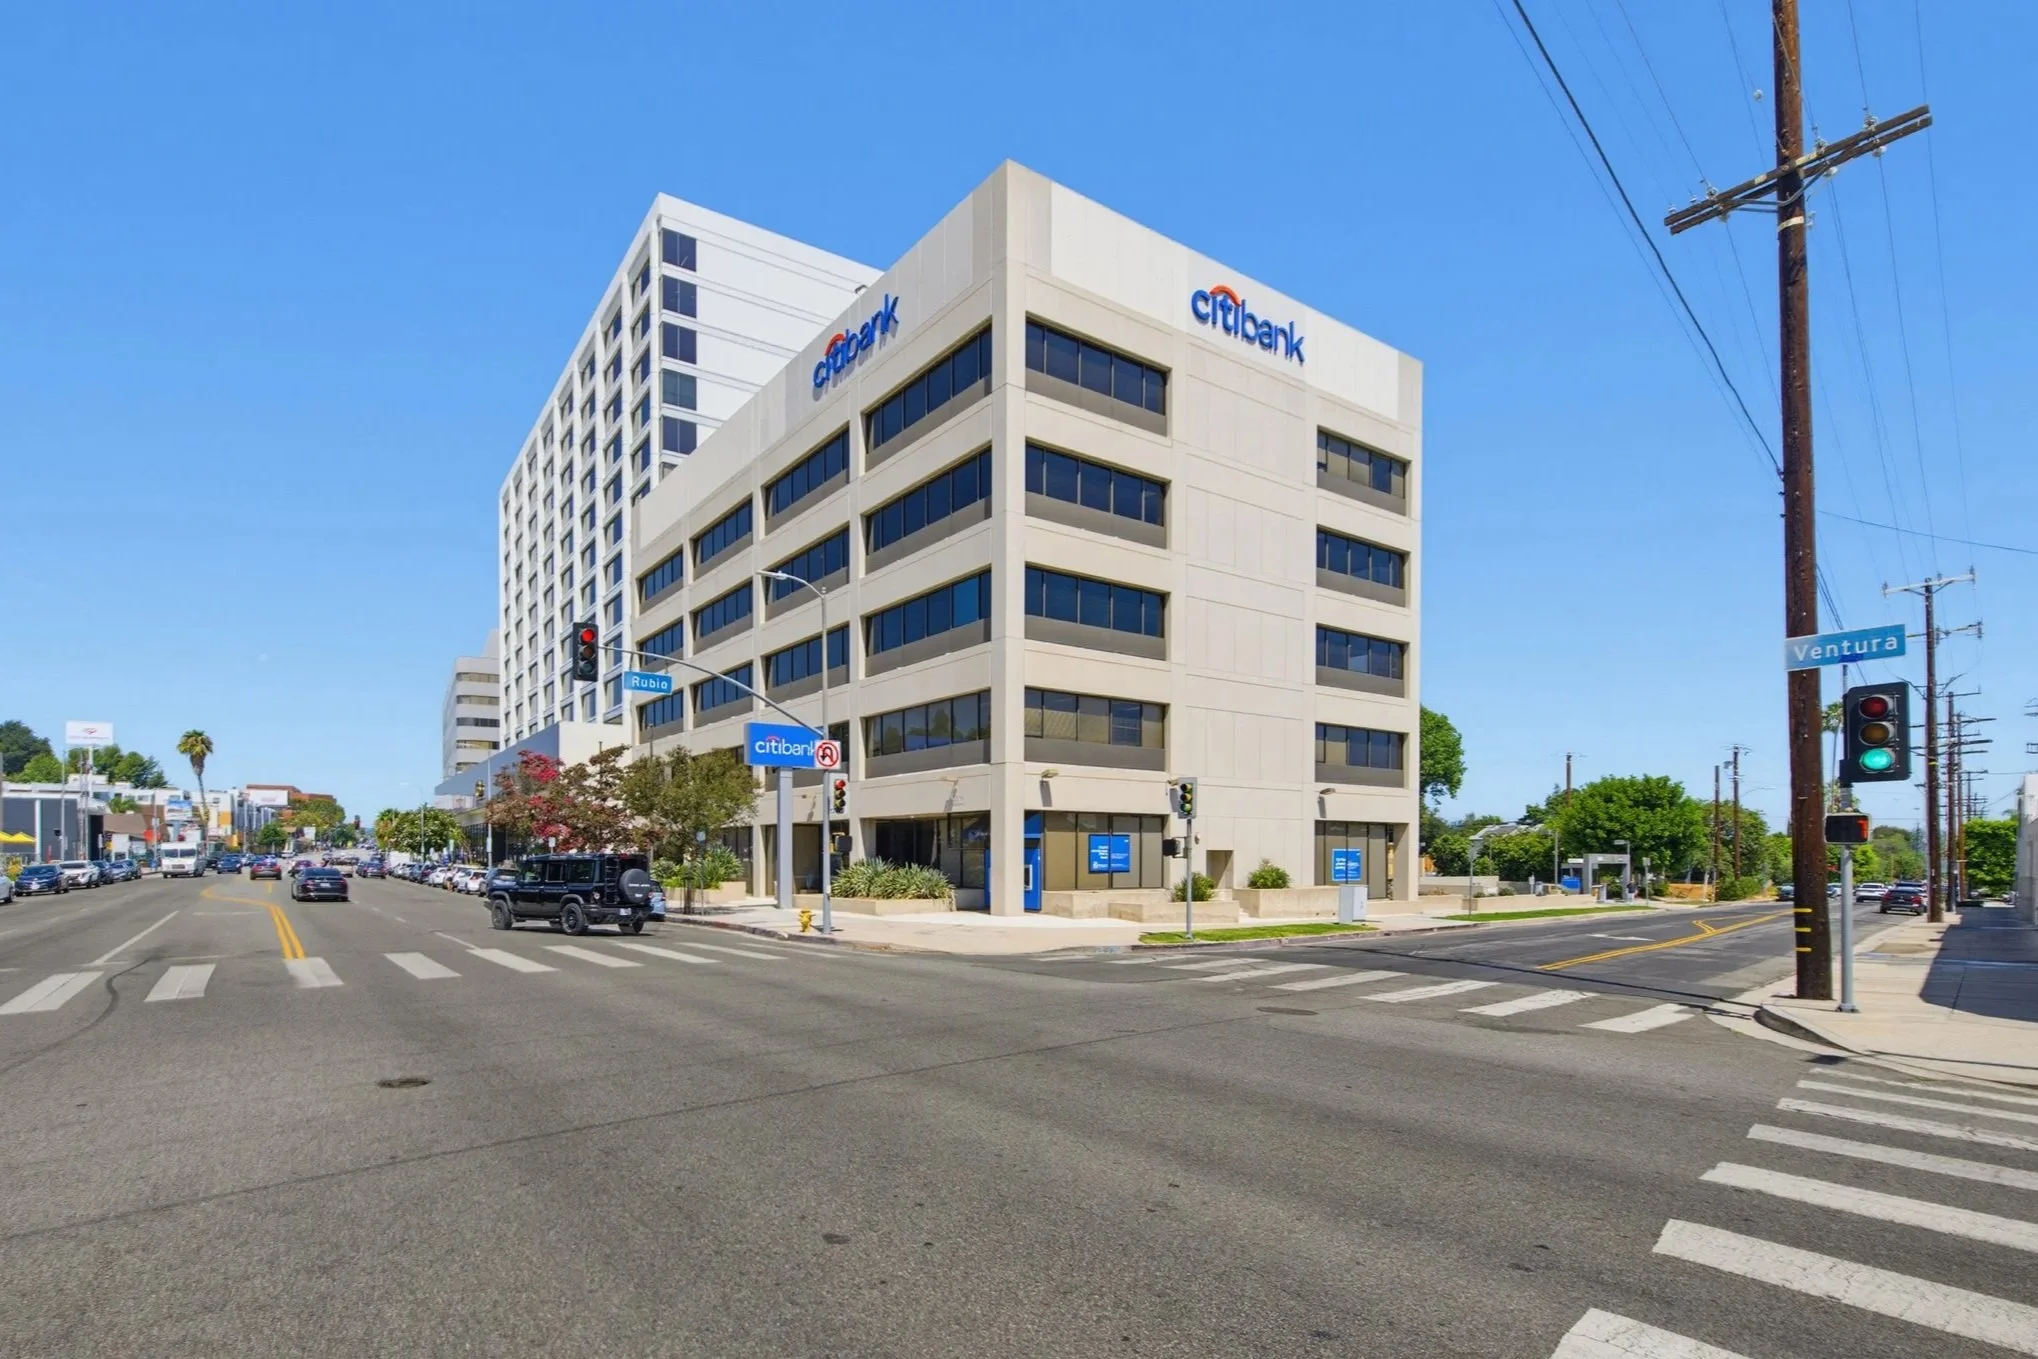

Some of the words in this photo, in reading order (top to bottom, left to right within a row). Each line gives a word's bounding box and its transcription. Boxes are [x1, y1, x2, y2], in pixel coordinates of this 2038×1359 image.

[813, 293, 899, 388] citibank
[1191, 285, 1304, 363] citibank
[1794, 636, 1898, 661] Ventura
[632, 675, 668, 689] Rubio
